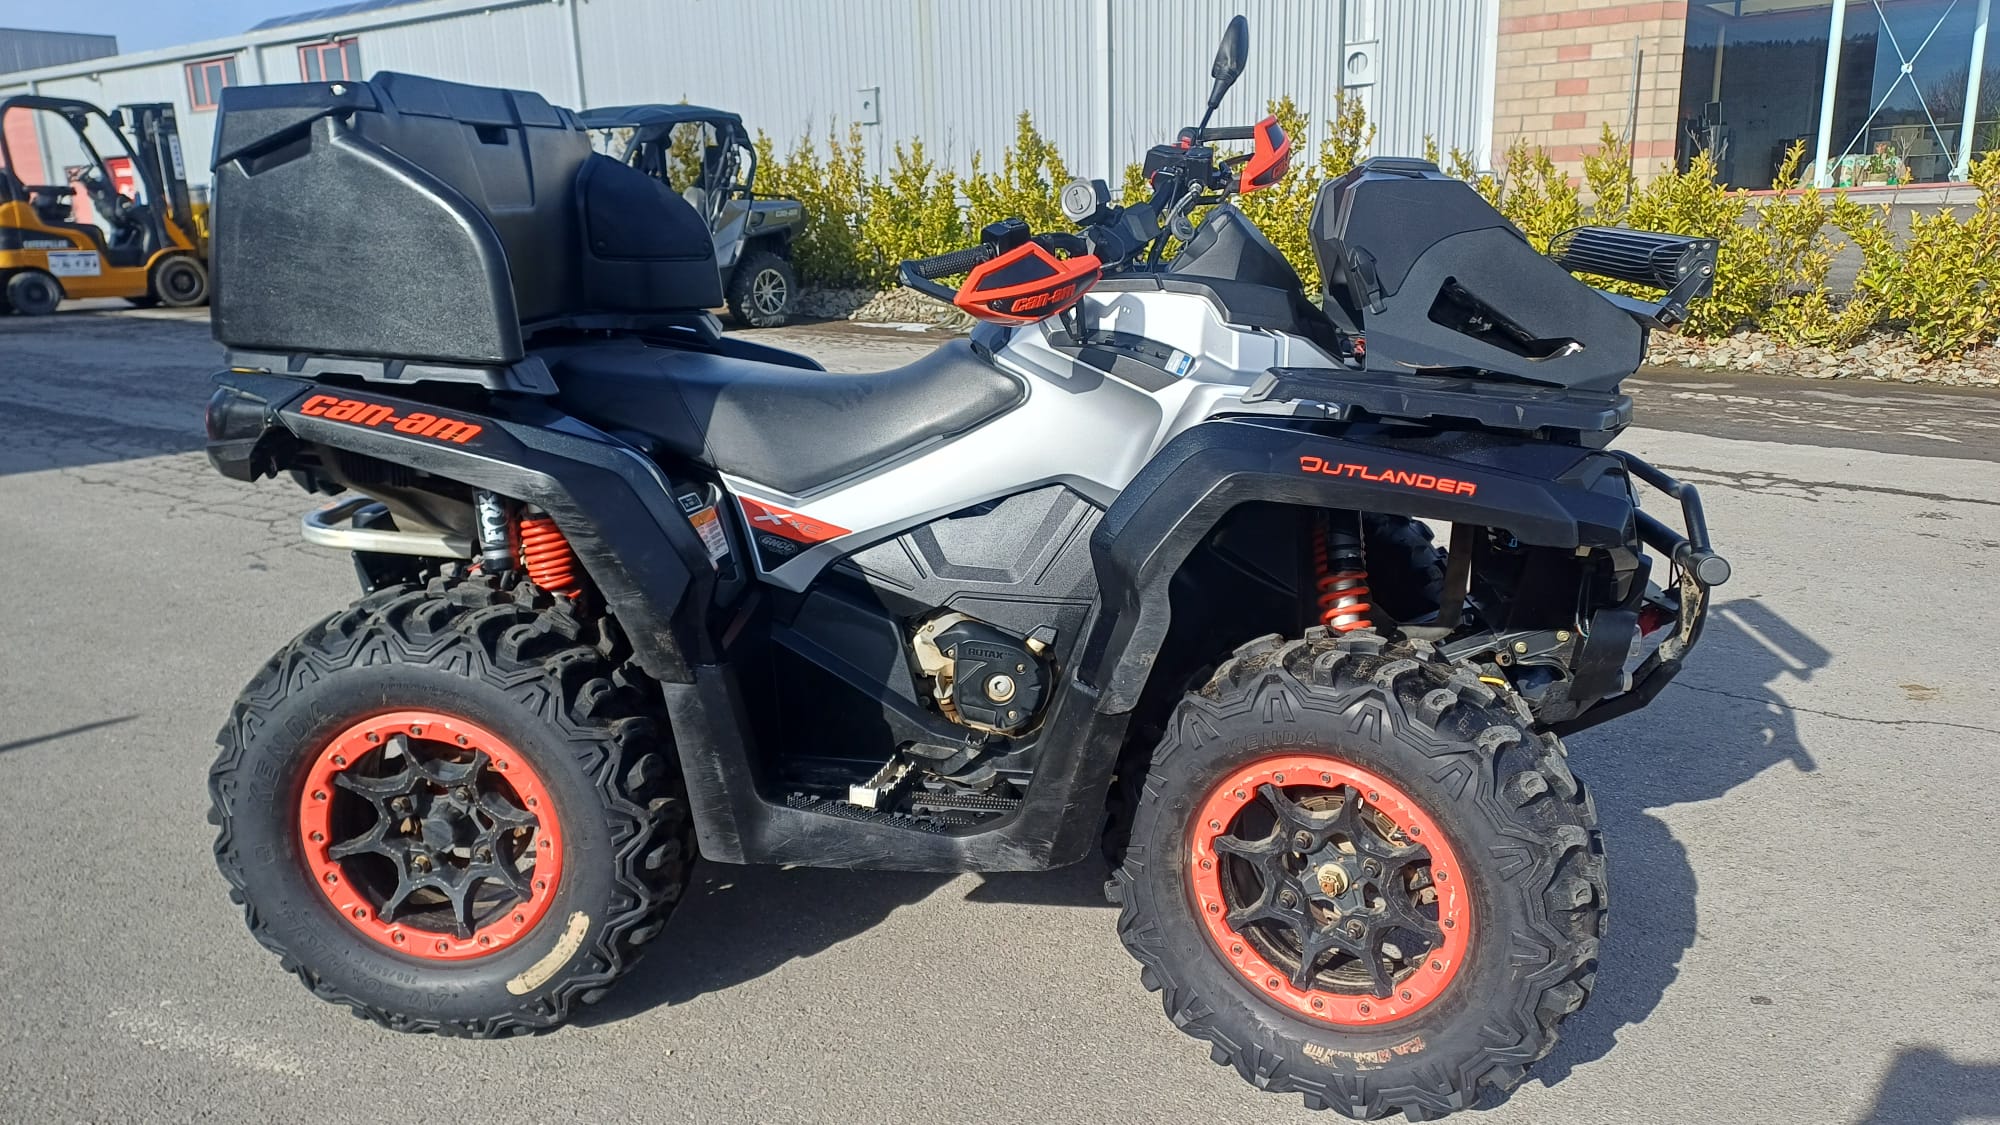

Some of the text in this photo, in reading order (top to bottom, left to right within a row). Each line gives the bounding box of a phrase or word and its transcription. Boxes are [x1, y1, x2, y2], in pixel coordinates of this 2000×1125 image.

[301, 394, 482, 444] can-am
[1299, 455, 1477, 497] OUTLANDER
[967, 647, 1004, 660] ROTAX
